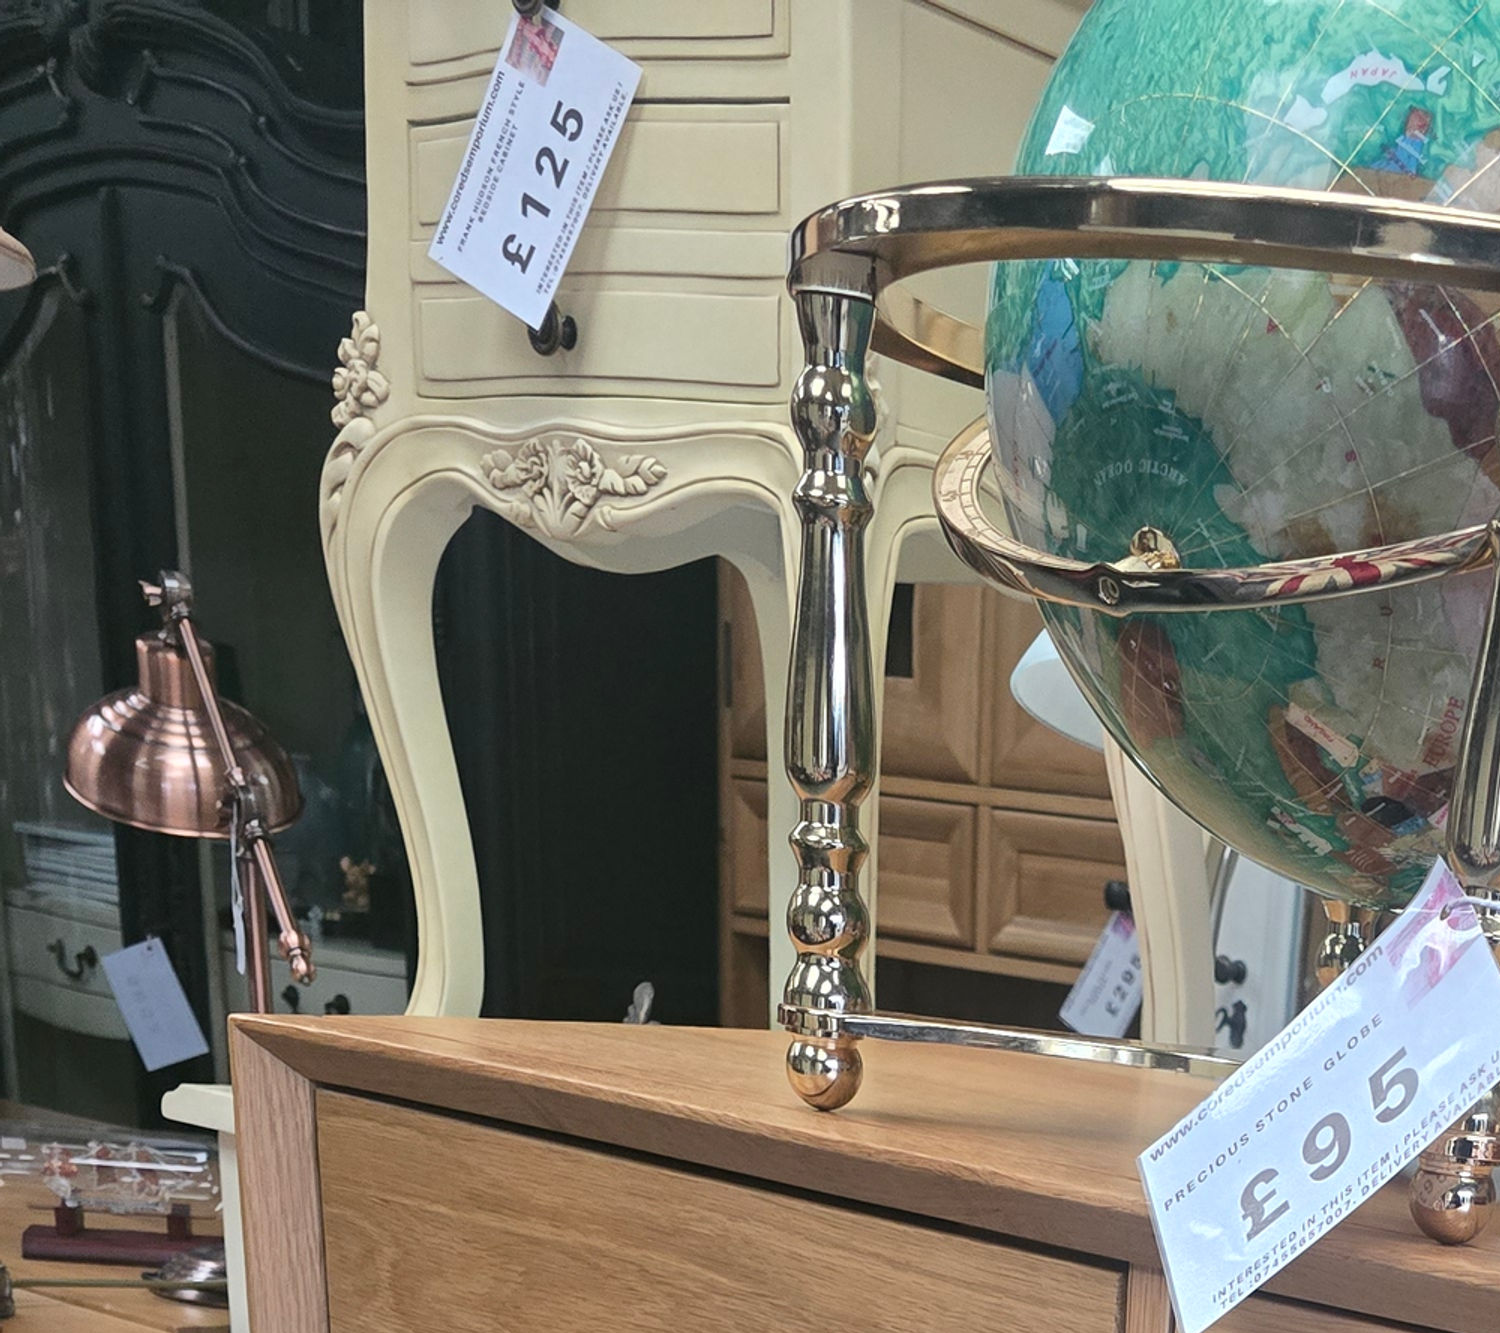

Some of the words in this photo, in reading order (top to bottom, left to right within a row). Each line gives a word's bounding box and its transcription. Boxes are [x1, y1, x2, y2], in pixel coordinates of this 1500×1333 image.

[437, 70, 506, 246] www.coredsemporium.com
[1349, 67, 1397, 79] JAPAN
[456, 214, 475, 253] FRANK
[471, 165, 494, 214] HUDSON
[490, 117, 511, 164] FRENCH
[507, 80, 525, 116] STYLE
[477, 174, 499, 223] BEDSIDE
[496, 122, 518, 173] CABINET
[564, 195, 578, 219] THIS
[1422, 694, 1466, 768] EUROPE
[1163, 1129, 1250, 1213] PRECIOUS
[1254, 1074, 1314, 1135] STONE
[1322, 1010, 1384, 1075] GLOBE
[1211, 1228, 1298, 1304] INTERESTED
[1300, 1212, 1317, 1233] IN
[1320, 1181, 1354, 1216] THIS
[1355, 1150, 1391, 1186] ITEM
[1401, 1090, 1457, 1146] PLEASE
[1457, 1061, 1489, 1095] ASK
[1239, 1046, 1420, 1240] £95
[1219, 1283, 1244, 1312] TEL
[1359, 1131, 1430, 1197] DELIVERY
